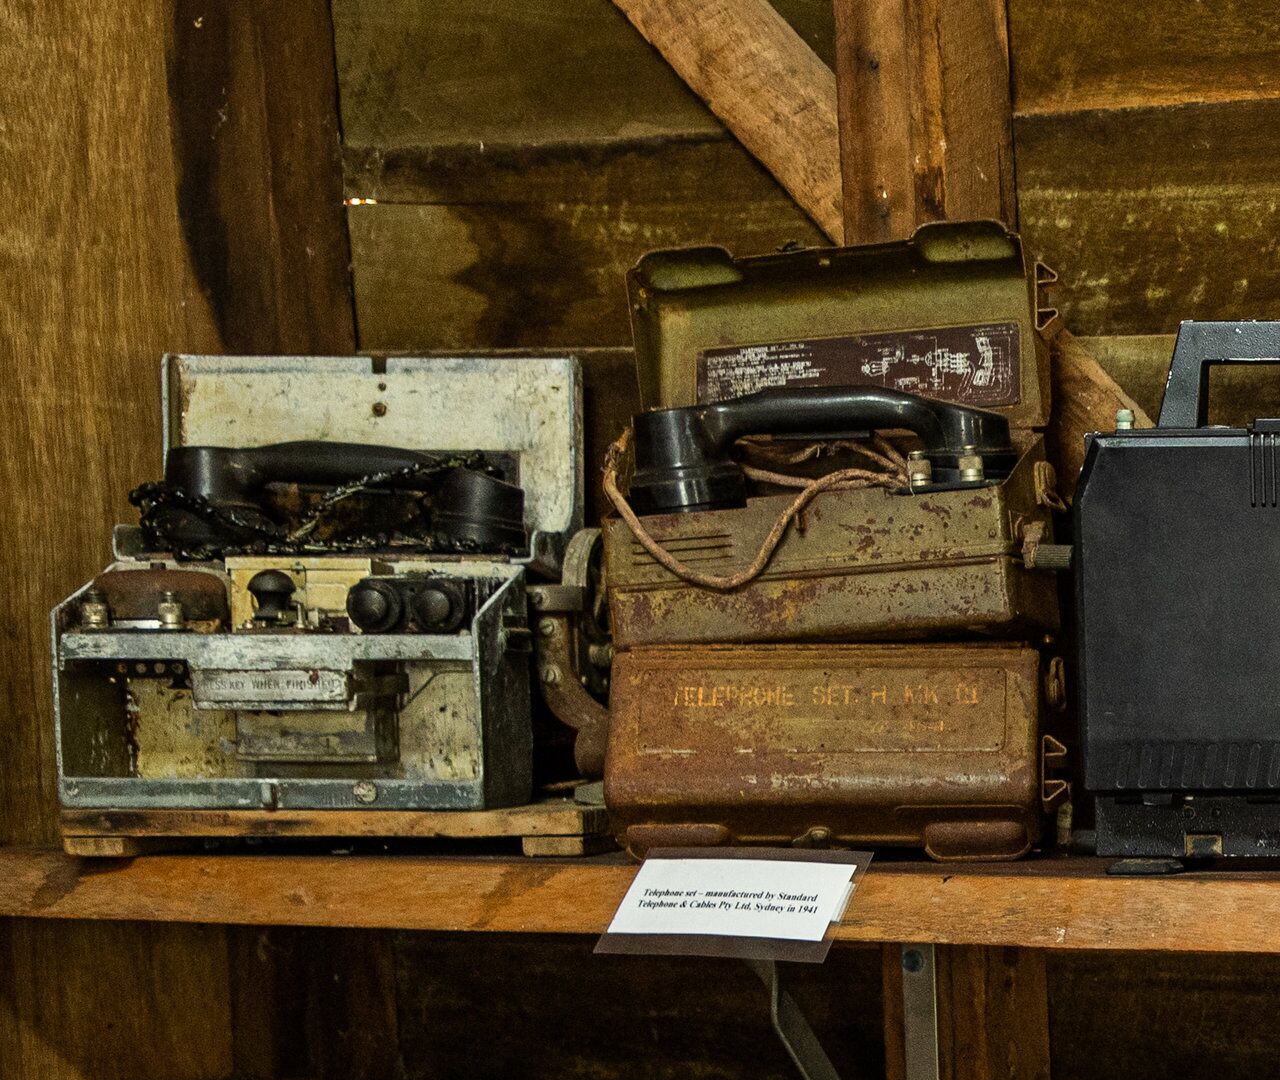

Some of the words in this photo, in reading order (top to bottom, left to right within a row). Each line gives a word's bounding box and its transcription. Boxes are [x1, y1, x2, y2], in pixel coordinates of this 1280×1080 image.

[644, 888, 683, 899] Telephone
[706, 890, 763, 899] manufactured
[765, 892, 774, 901] by
[778, 892, 818, 902] Standard
